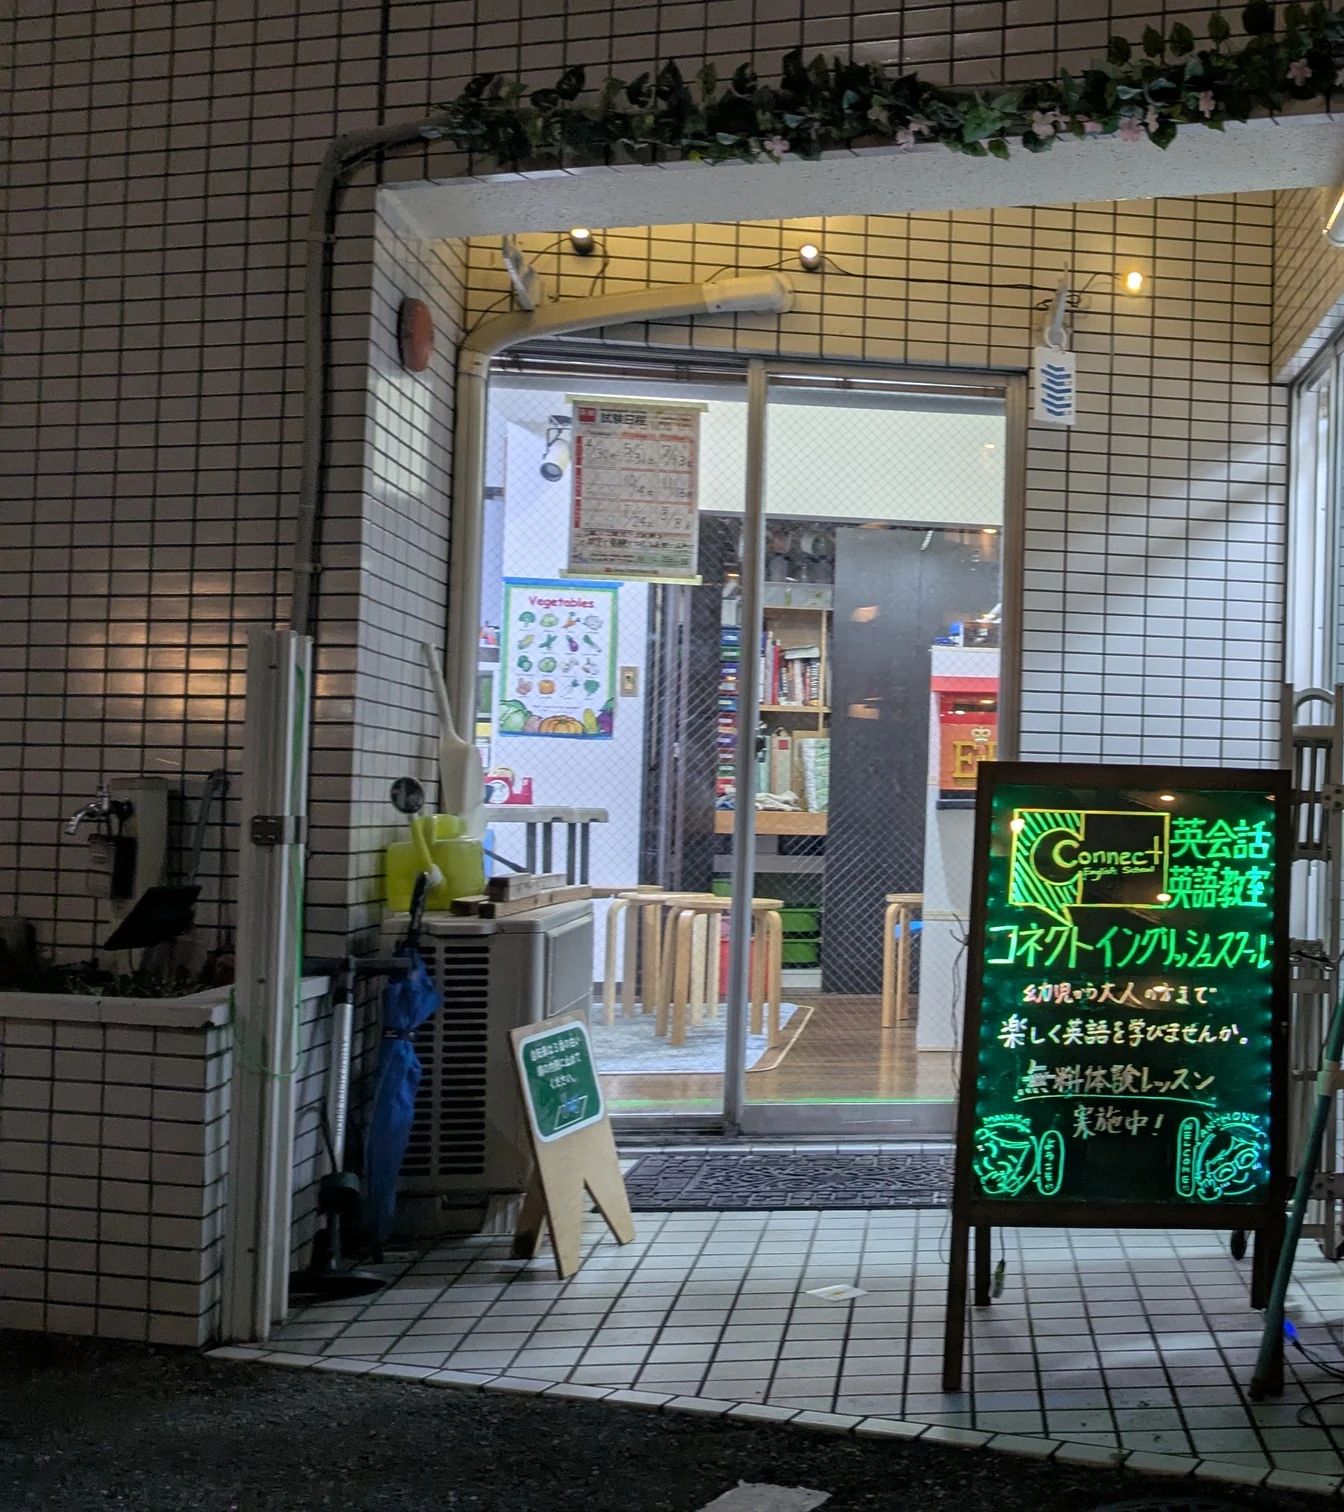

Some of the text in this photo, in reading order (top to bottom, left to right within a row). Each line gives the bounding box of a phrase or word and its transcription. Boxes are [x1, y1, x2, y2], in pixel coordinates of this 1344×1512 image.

[529, 596, 595, 609] Vegetables
[1052, 836, 1163, 868] Connect
[1169, 817, 1271, 859] 英会話
[1167, 866, 1271, 908] 英語教室
[998, 1013, 1249, 1048] 楽しく英語を学びませんか。
[1016, 1059, 1215, 1094] 無料体験レッスン
